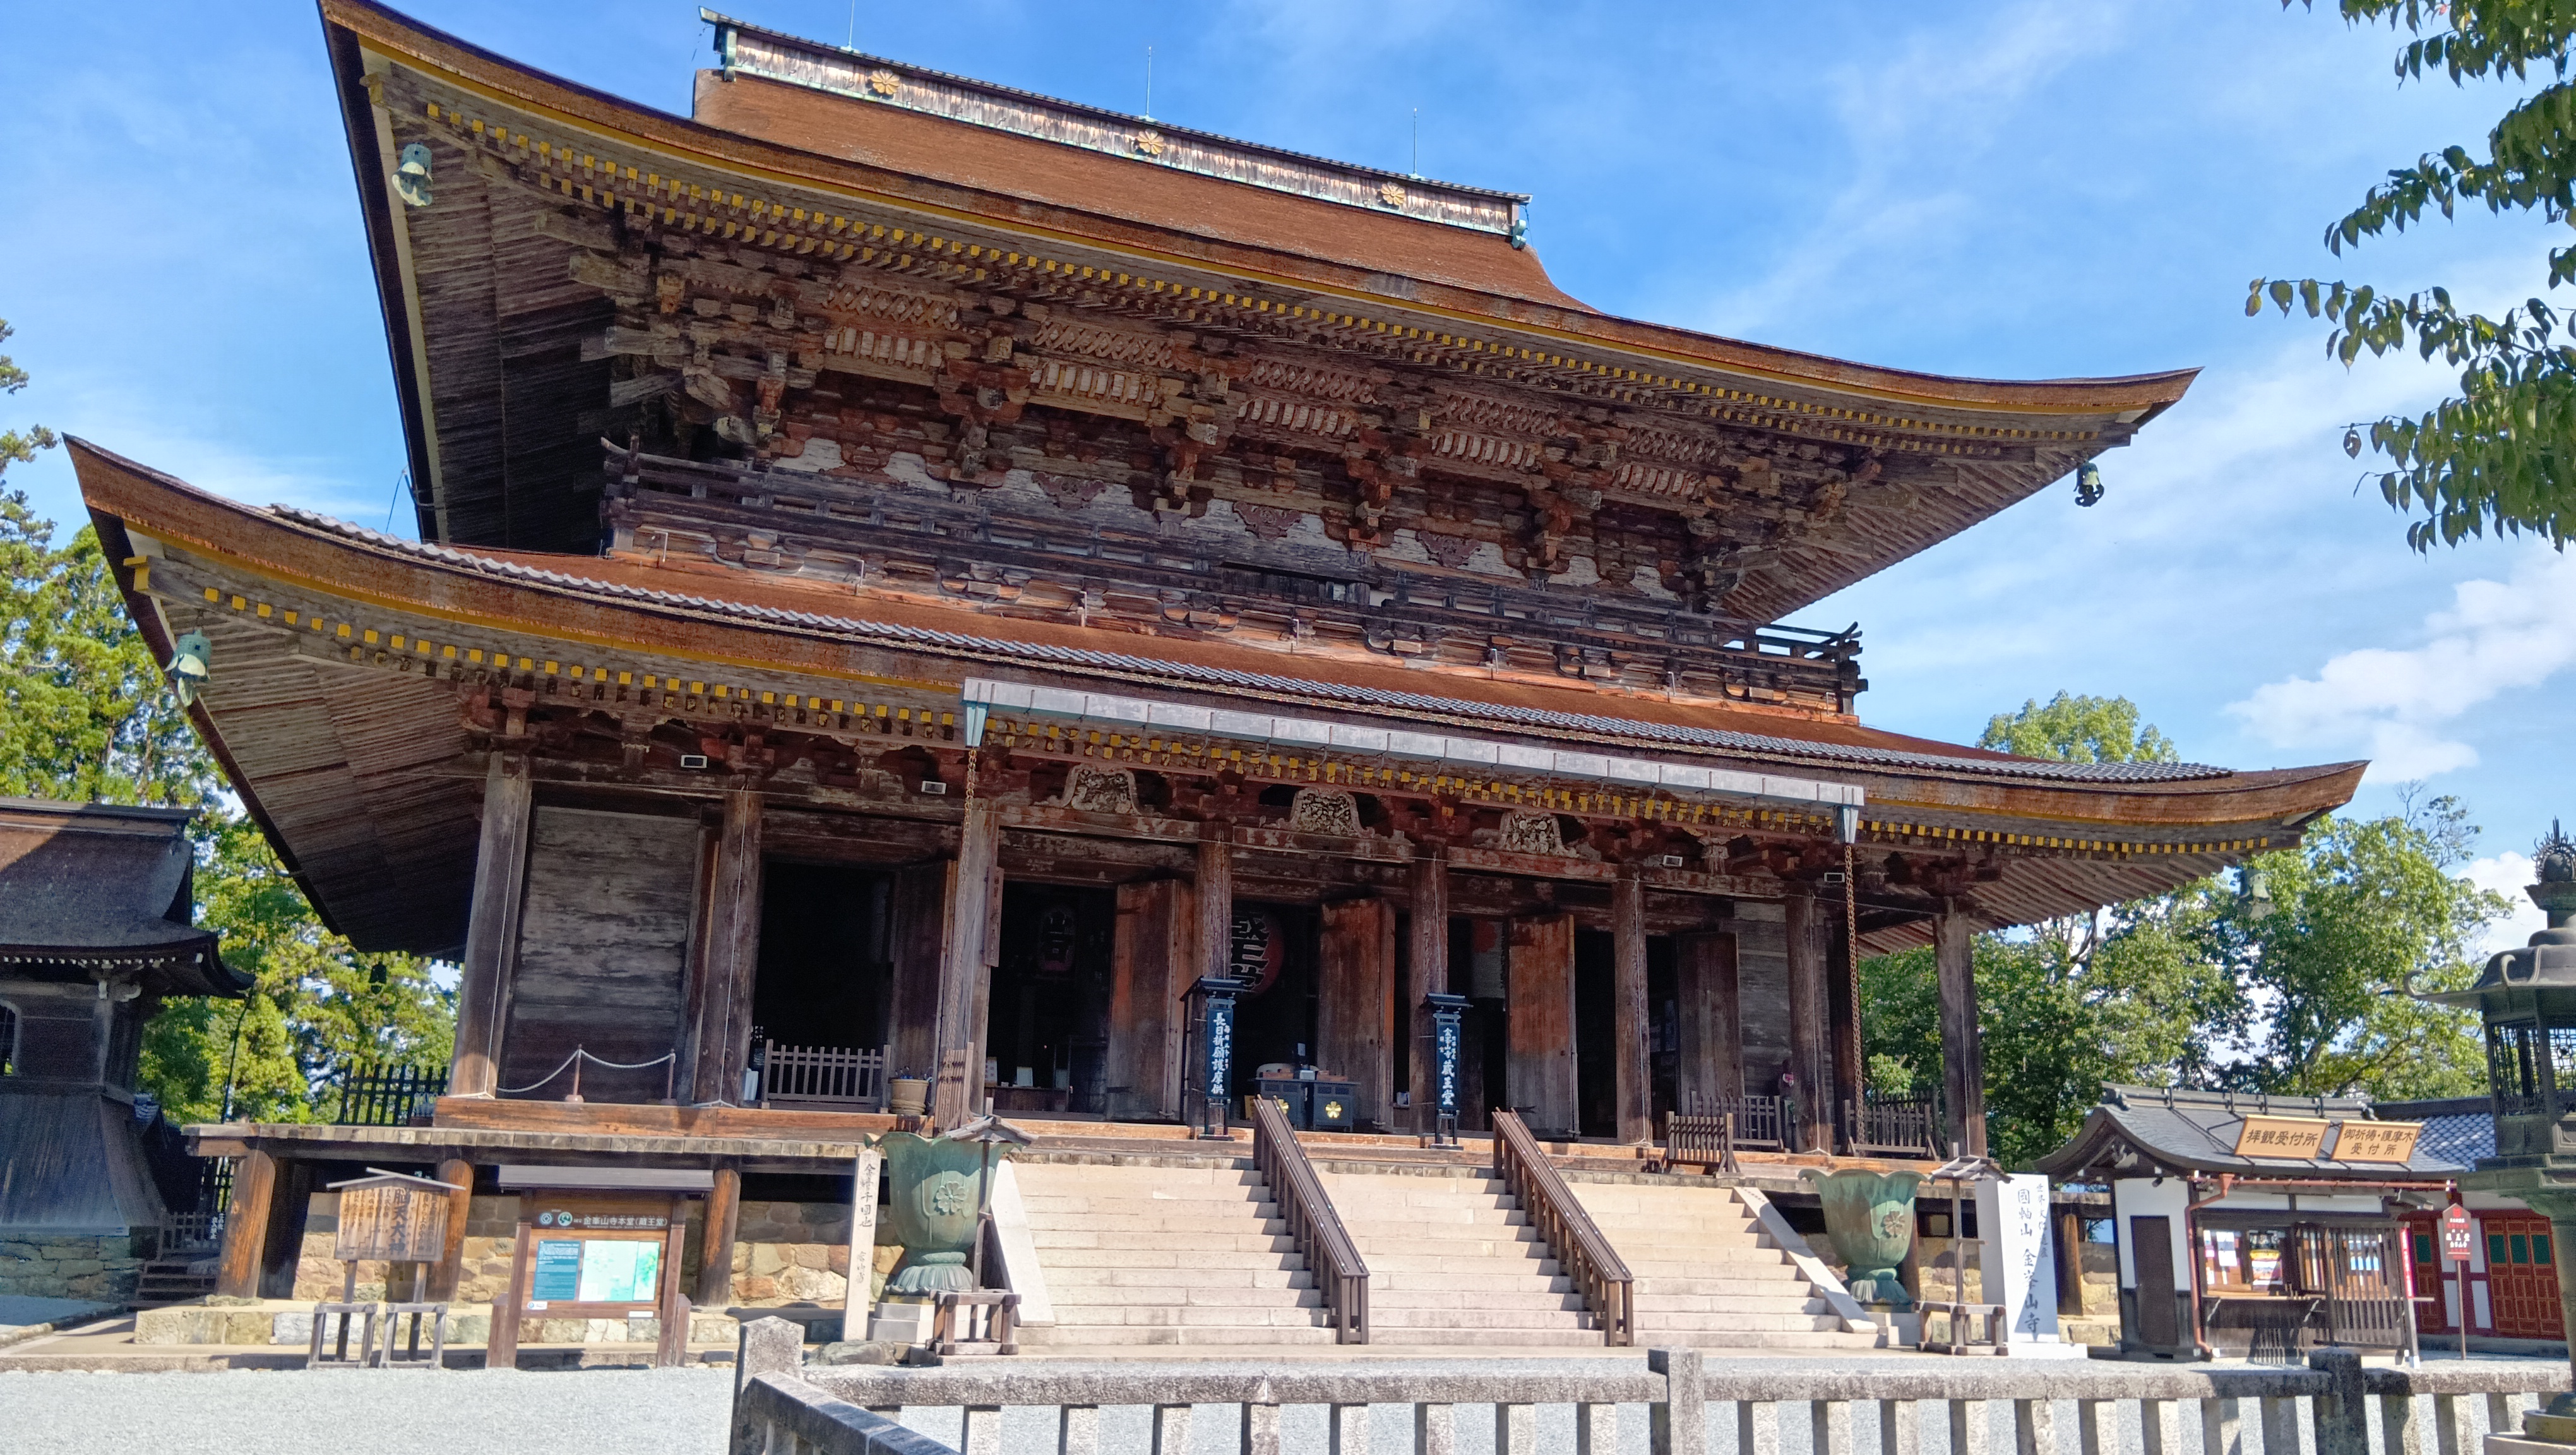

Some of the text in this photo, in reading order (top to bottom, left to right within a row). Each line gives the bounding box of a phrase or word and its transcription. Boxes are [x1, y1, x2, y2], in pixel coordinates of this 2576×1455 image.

[1211, 1012, 1226, 1094] 長日祈願護摩供
[2246, 1129, 2319, 1146] 拝観受付所
[2350, 1142, 2397, 1156] 受付所
[388, 1188, 411, 1255] 脳天大神
[2036, 1183, 2049, 1259] 世界文化遺産
